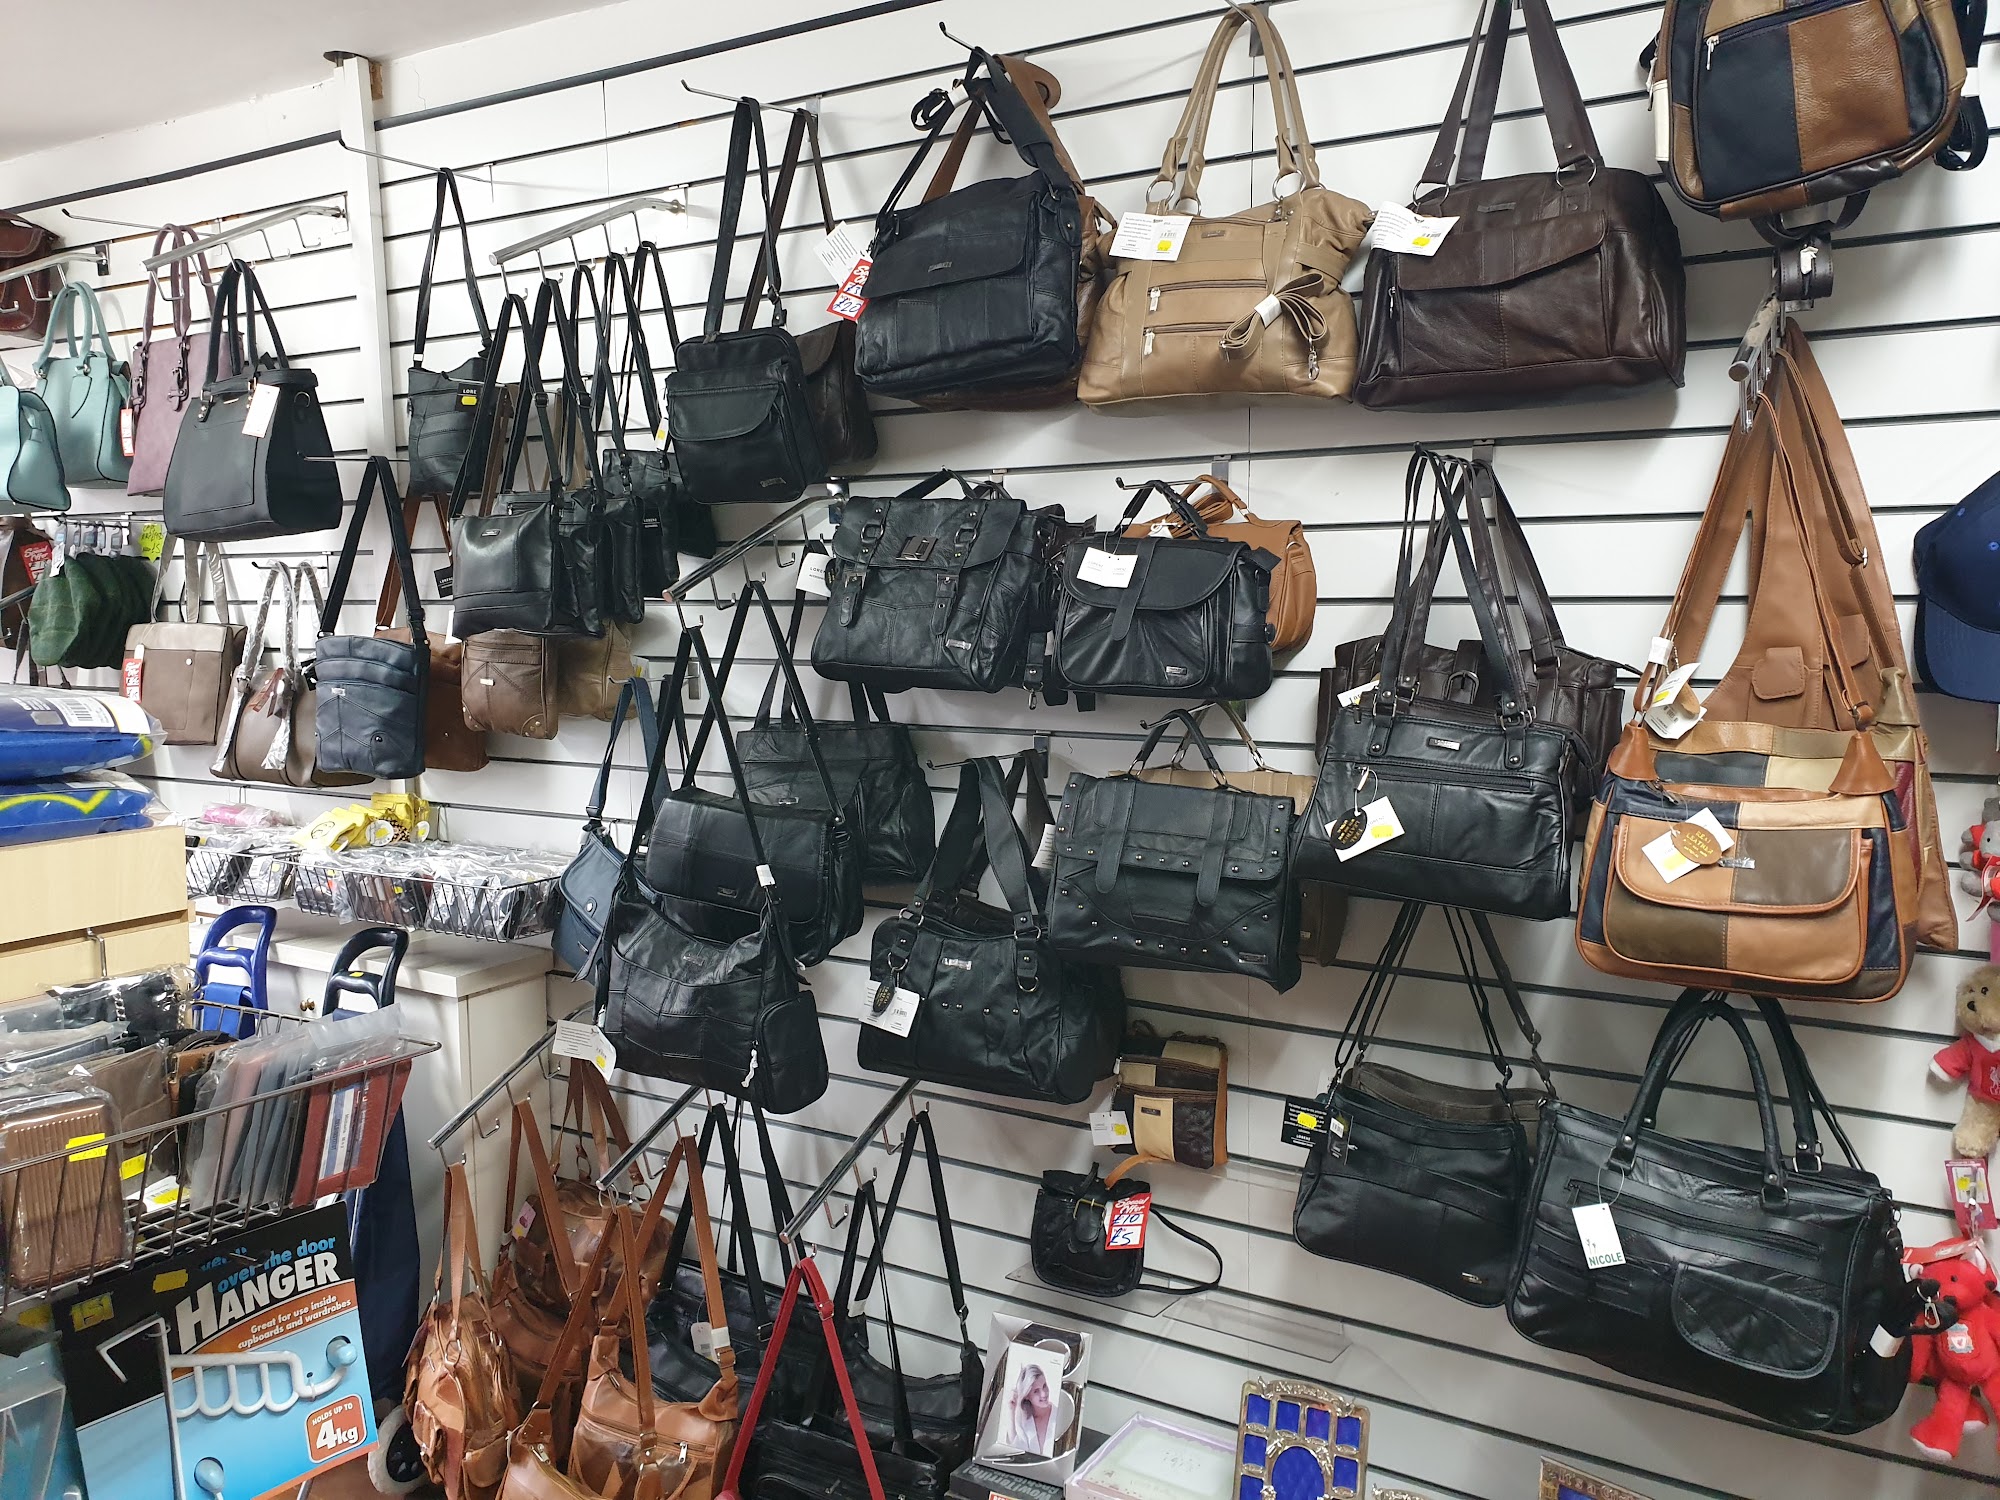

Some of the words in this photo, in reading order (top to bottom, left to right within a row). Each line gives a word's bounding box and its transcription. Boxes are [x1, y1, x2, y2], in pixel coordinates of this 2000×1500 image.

[834, 297, 862, 313] £20
[1111, 1212, 1140, 1226] £10
[1120, 1205, 1146, 1215] Offer
[1107, 1227, 1134, 1247] £5
[217, 1265, 259, 1293] over
[296, 1236, 336, 1258] door
[1588, 1252, 1624, 1267] NICOLE
[238, 1322, 284, 1350] cupboards
[286, 1316, 304, 1330] and
[305, 1299, 352, 1323] wardrobes
[250, 1318, 277, 1334] Great
[278, 1312, 291, 1325] for
[293, 1305, 309, 1317] use
[311, 1294, 337, 1311] inside
[312, 1409, 333, 1426] HOLDS
[333, 1405, 343, 1415] UP
[344, 1402, 354, 1411] TO
[316, 1419, 358, 1450] 4kg
